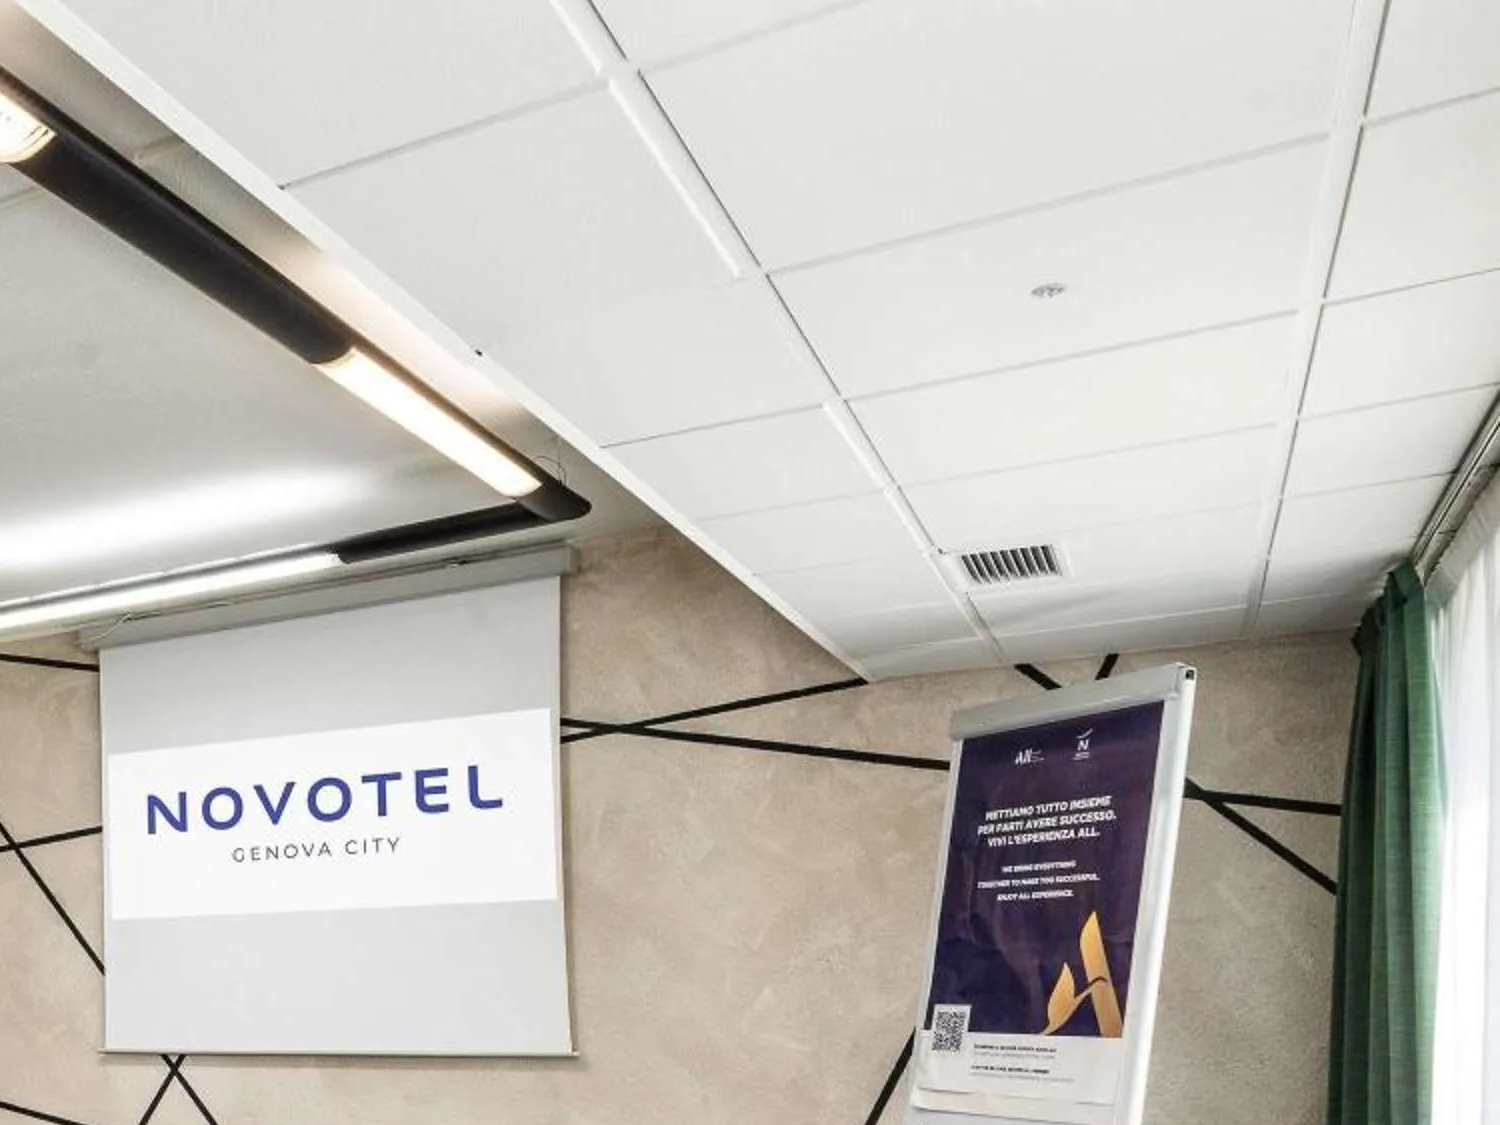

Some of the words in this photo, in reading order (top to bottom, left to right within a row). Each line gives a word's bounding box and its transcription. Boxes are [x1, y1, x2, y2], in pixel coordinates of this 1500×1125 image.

[147, 765, 503, 835] NOVOTEL
[985, 806, 1034, 821] METTIAMO
[1036, 801, 1068, 814] TUTTO
[1070, 795, 1112, 811] INSIEME
[978, 824, 995, 836] PER
[1025, 816, 1058, 830] AVERE
[1059, 810, 1117, 825] SUCCESSO.
[232, 842, 332, 863] GENOVA
[345, 837, 400, 856] CITY
[987, 836, 1006, 847] VIVI
[1077, 827, 1100, 838] ALL.
